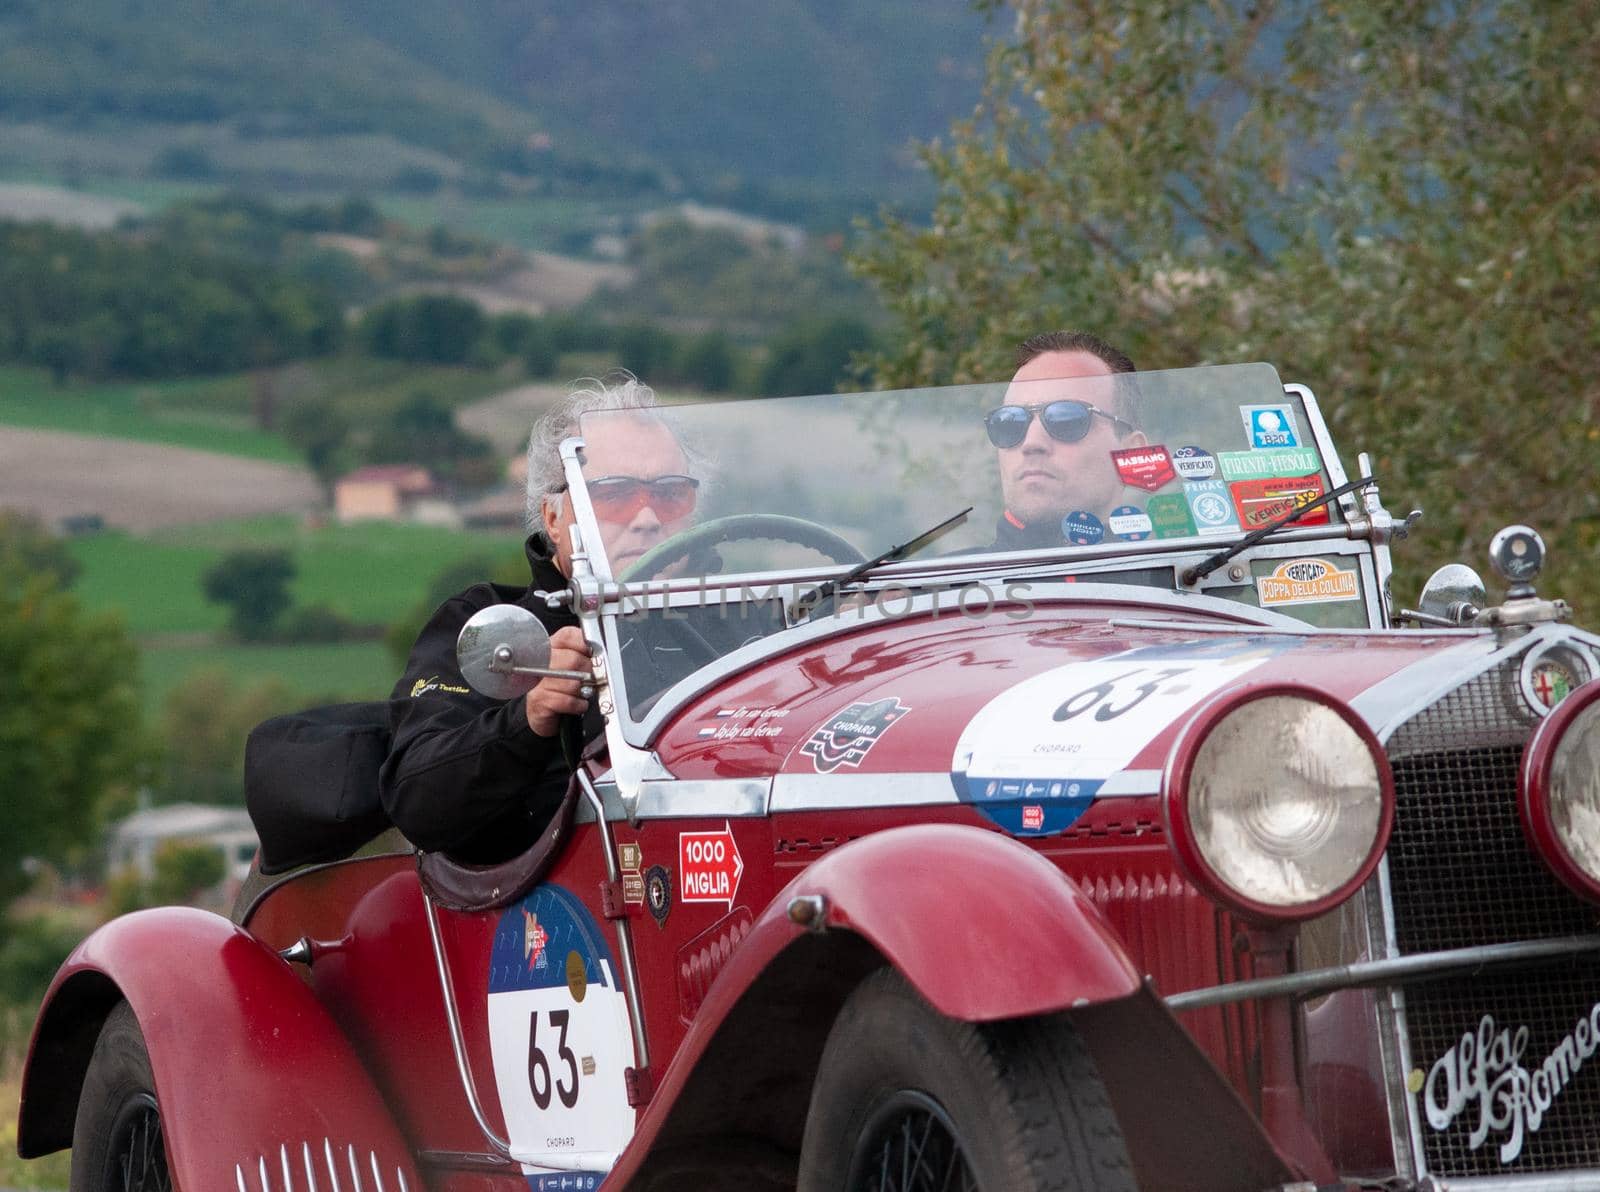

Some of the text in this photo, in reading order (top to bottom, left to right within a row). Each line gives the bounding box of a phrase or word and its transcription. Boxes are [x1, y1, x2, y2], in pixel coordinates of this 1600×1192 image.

[1264, 434, 1286, 445] B20
[1116, 453, 1166, 467] BASSANO
[1177, 460, 1213, 471] VERIFICATO
[1249, 489, 1317, 522] VERIFICATO
[1286, 563, 1325, 581] VERIFICATO
[1262, 573, 1354, 598] COPPA DELLA COLLINA
[1052, 667, 1197, 723] 63
[833, 721, 877, 735] CHOPARD
[1033, 744, 1081, 753] CHOPARD
[685, 840, 725, 863] 1000
[685, 871, 730, 895] MIGLIA
[528, 1009, 579, 1111] 63
[1425, 1014, 1528, 1150] Alfa
[546, 1137, 575, 1148] CHOPARD
